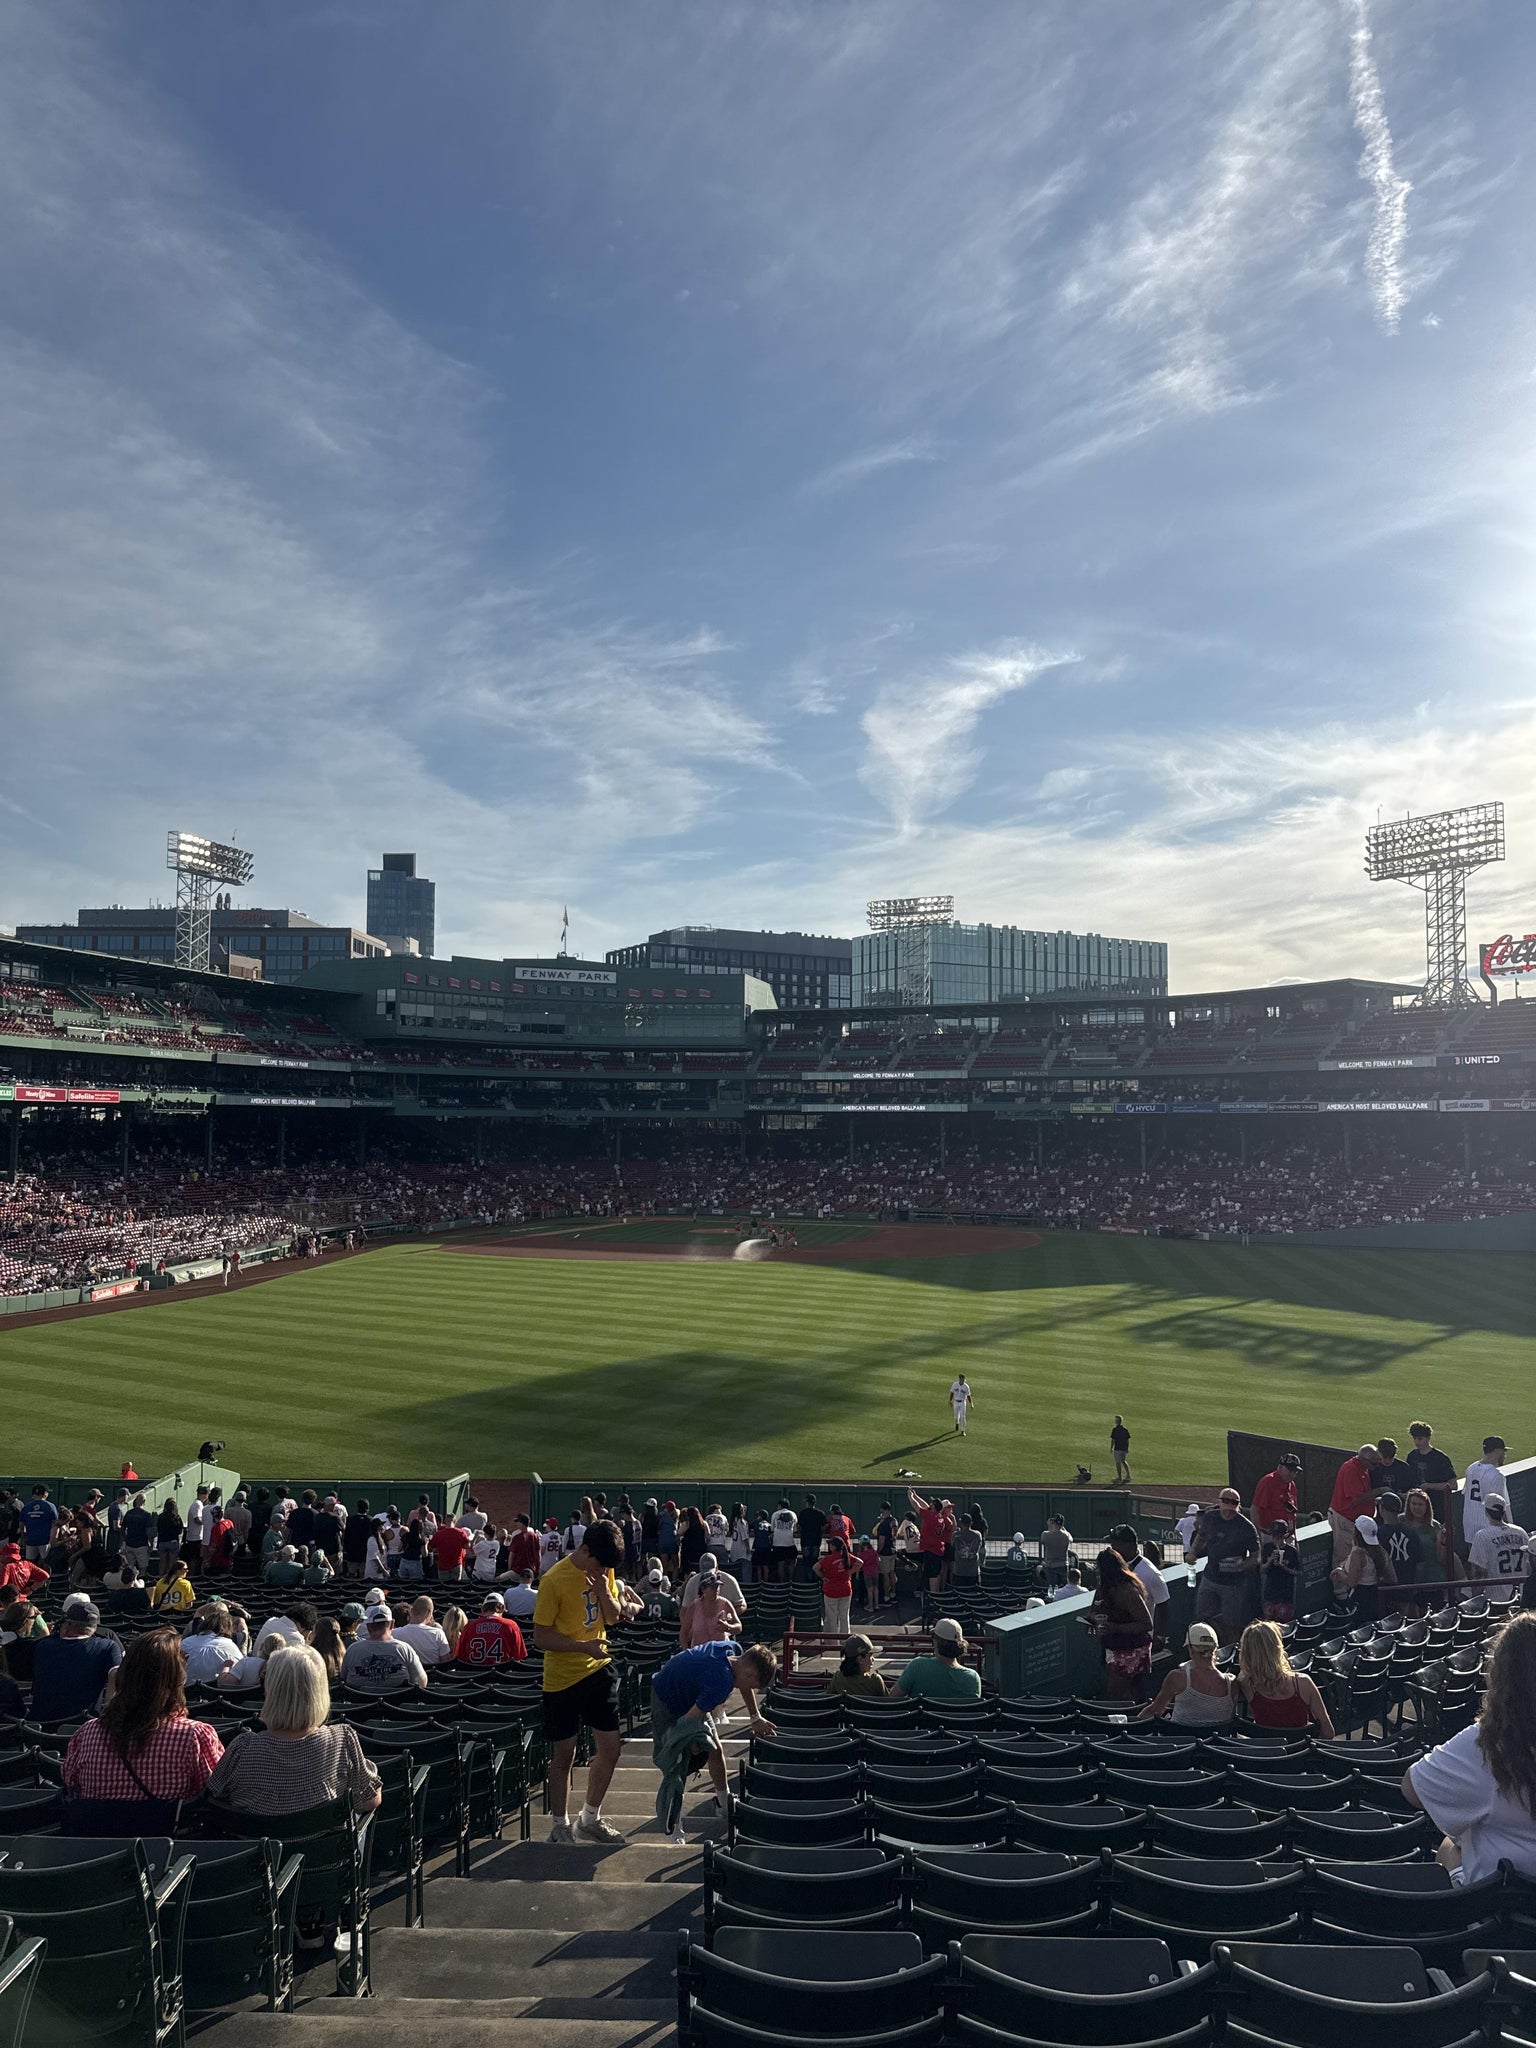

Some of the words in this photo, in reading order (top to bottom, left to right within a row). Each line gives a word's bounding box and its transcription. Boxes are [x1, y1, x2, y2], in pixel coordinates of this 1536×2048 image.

[522, 969, 571, 979] FENWAY
[578, 973, 610, 982] PARK
[70, 1092, 95, 1100] Safelite
[1470, 1479, 1481, 1502] 2
[1388, 1531, 1410, 1561] NY
[1492, 1534, 1523, 1548] STANTON
[488, 1548, 495, 1559] 2
[1013, 1551, 1022, 1561] 16
[1498, 1549, 1525, 1573] 27
[582, 1589, 600, 1627] B
[648, 1604, 662, 1617] 19
[476, 1622, 502, 1634] ORTIZ
[469, 1637, 505, 1664] 34
